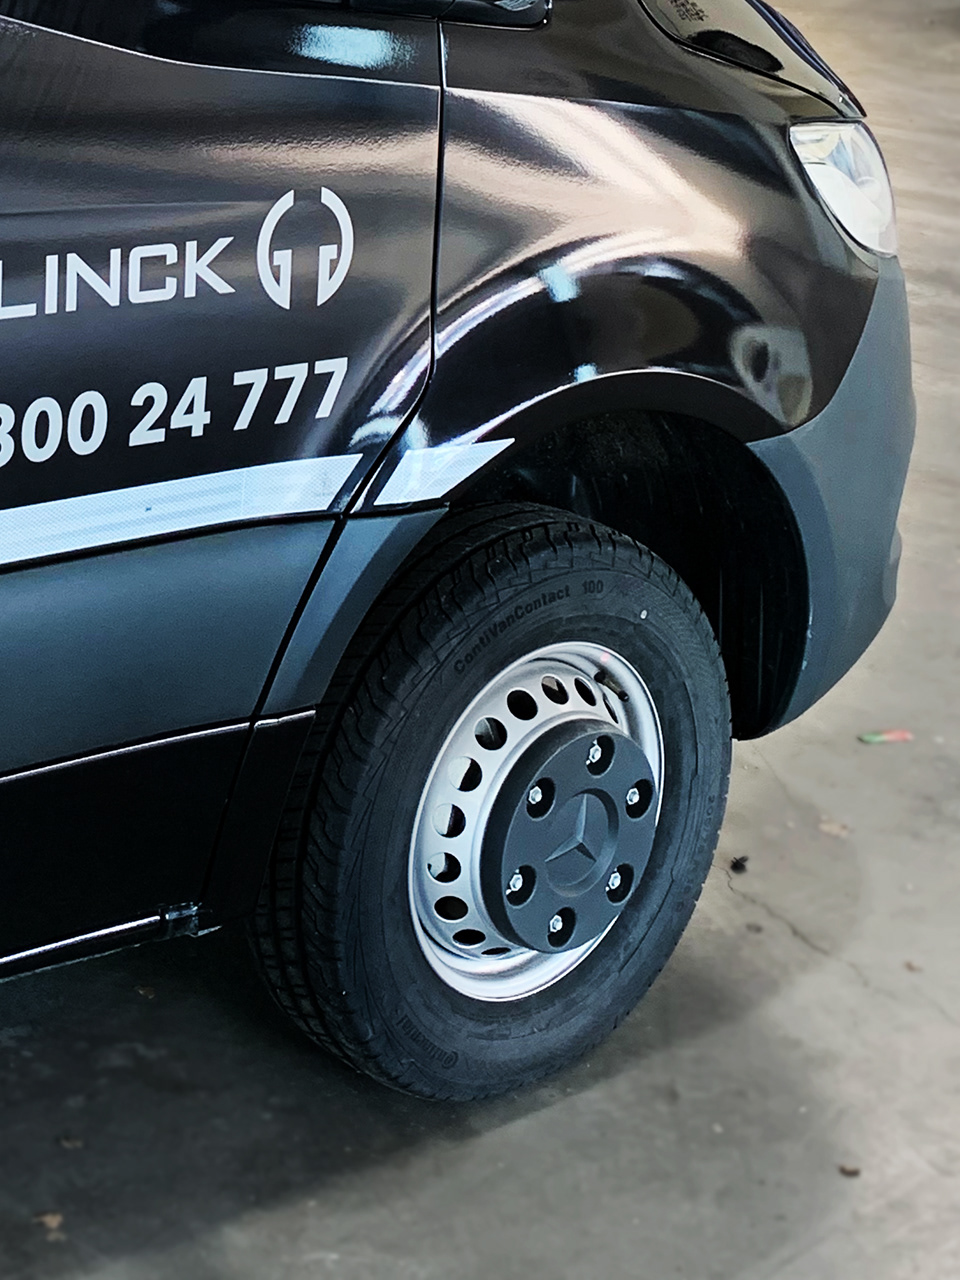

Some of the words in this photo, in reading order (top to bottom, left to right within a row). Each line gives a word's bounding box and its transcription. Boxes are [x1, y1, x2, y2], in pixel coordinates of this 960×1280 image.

[128, 376, 211, 447] 24
[233, 356, 348, 431] 777
[453, 584, 571, 675] ContiVanContact
[582, 579, 604, 595] 100
